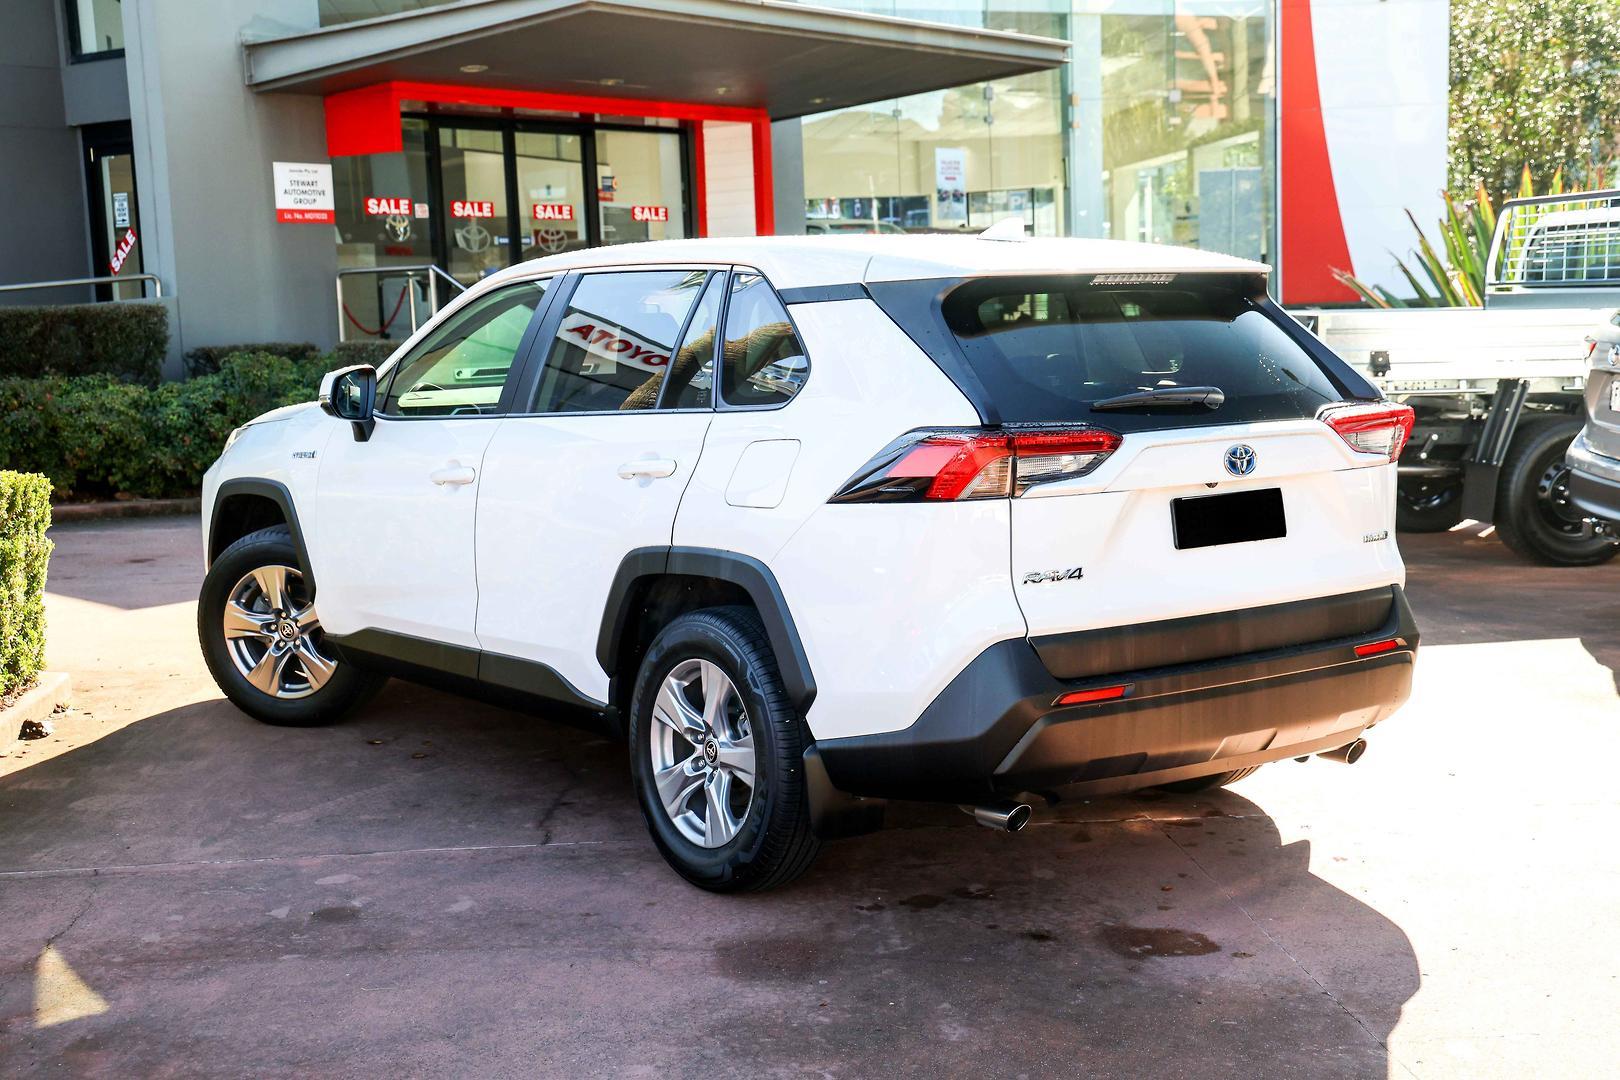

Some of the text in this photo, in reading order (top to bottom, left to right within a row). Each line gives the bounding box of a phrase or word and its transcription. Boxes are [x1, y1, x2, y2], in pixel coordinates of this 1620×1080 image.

[289, 179, 318, 187] STEWART
[283, 188, 326, 196] AUTOMOTIVE
[367, 198, 410, 215] SALE
[453, 202, 492, 217] SALE
[535, 205, 571, 219] SALE
[634, 207, 666, 221] SALE
[111, 229, 136, 272] SALE
[1023, 567, 1083, 585] RAV4
